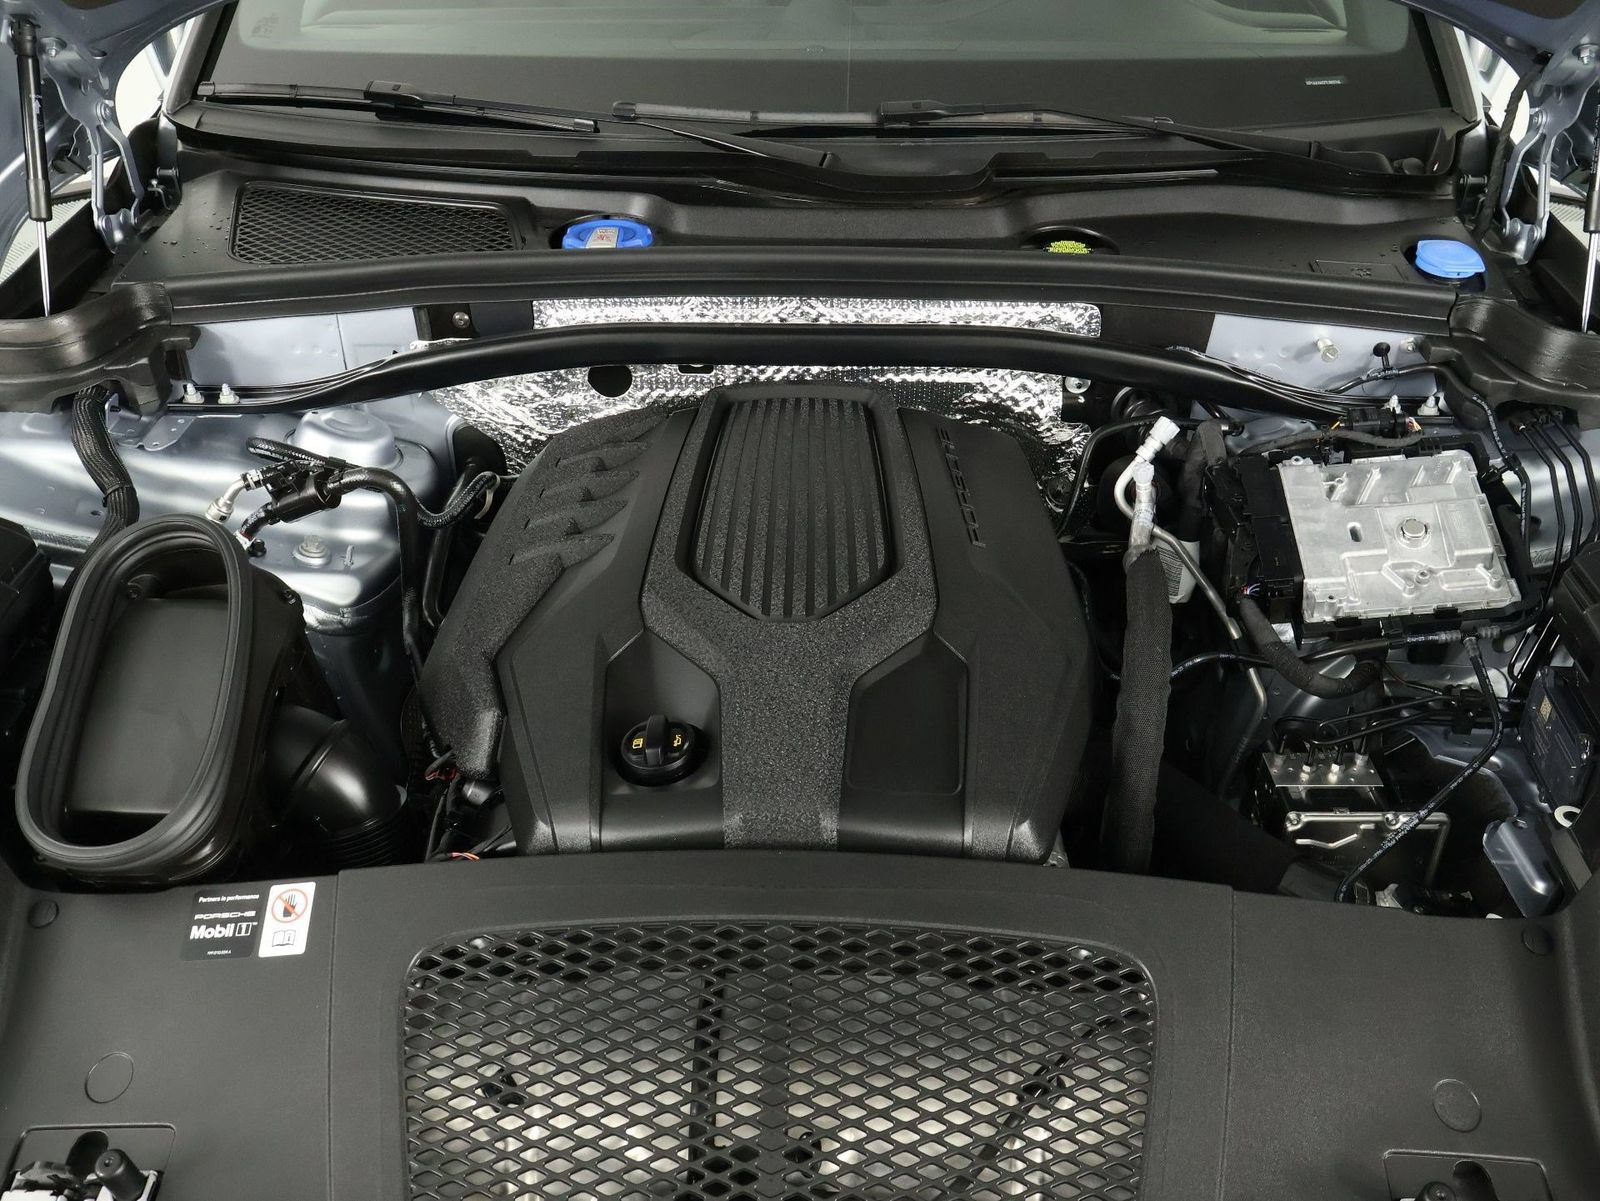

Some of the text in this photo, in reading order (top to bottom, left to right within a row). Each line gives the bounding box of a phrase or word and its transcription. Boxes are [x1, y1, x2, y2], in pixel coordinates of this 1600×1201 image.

[935, 425, 987, 549] PORSCHE
[194, 911, 256, 920] PORSCHE
[190, 924, 235, 939] Mobil
